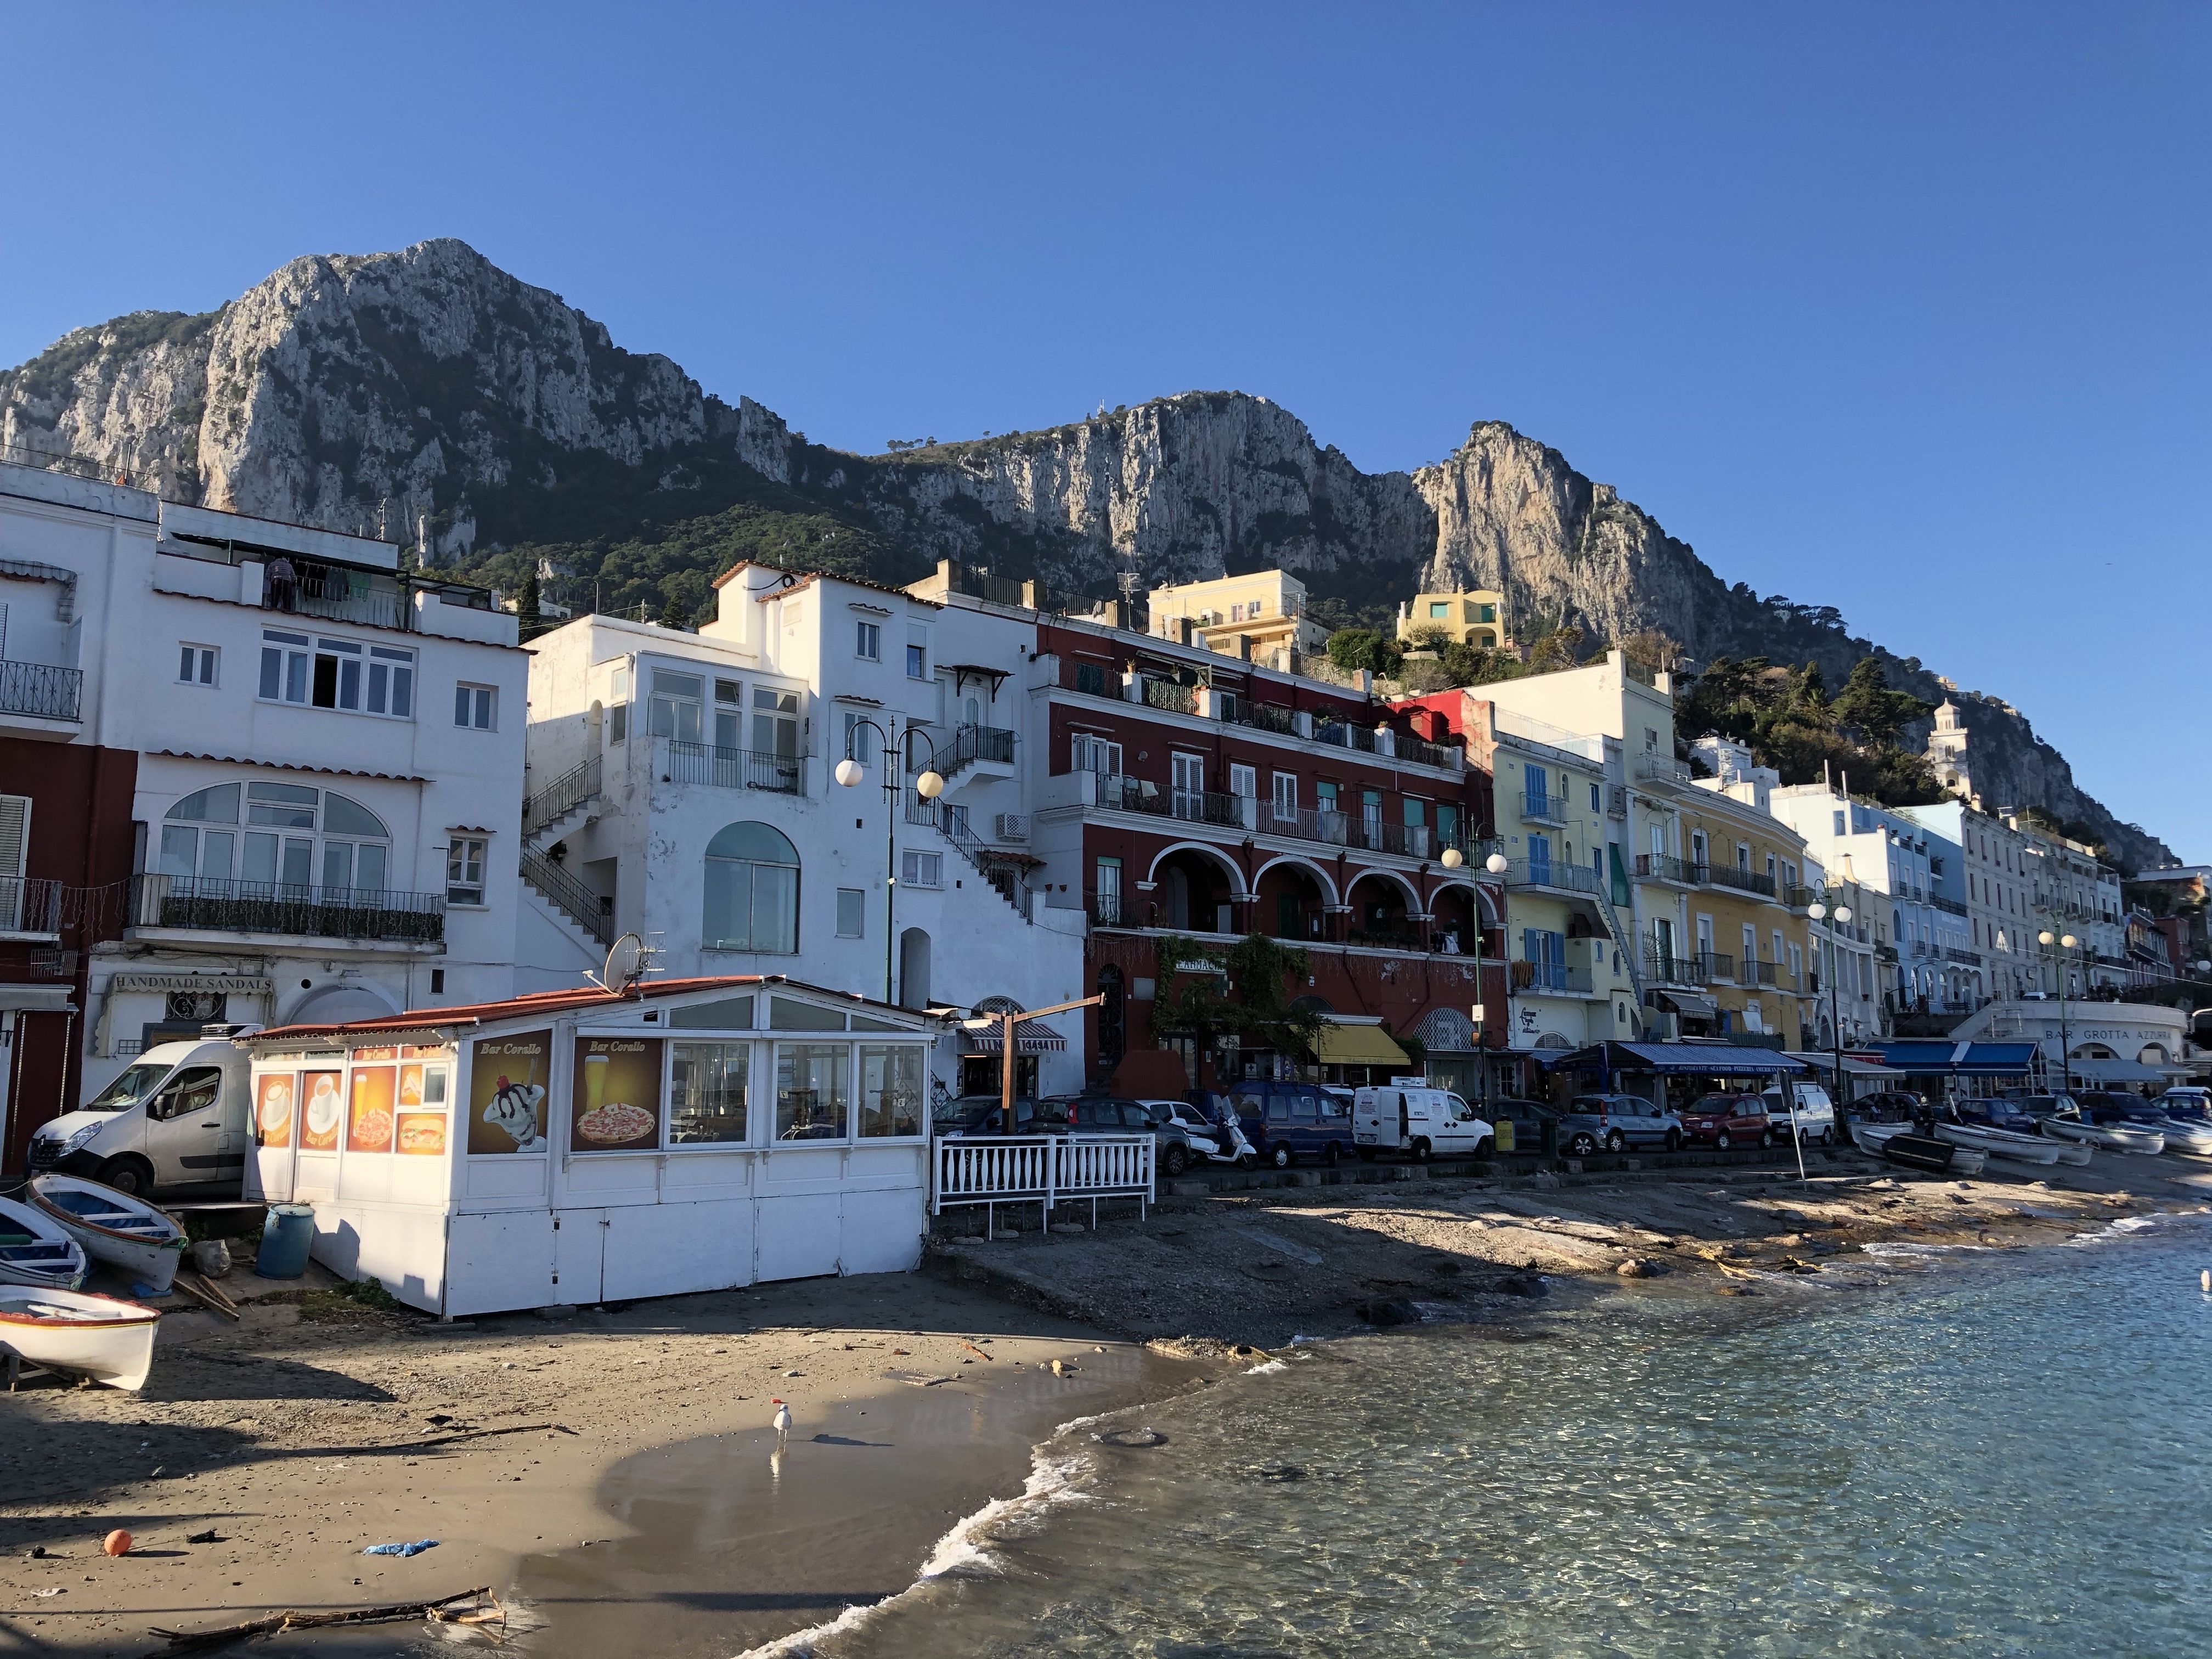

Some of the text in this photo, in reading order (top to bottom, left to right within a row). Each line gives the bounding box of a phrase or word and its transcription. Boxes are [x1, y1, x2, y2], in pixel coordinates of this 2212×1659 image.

[116, 976, 271, 990] HANDMADE SANDALS
[2046, 1030, 2074, 1039] BAR
[2084, 1030, 2129, 1039] GROTTA
[481, 1043, 541, 1054] Bar Corallo
[589, 1041, 645, 1052] Bar Corallo
